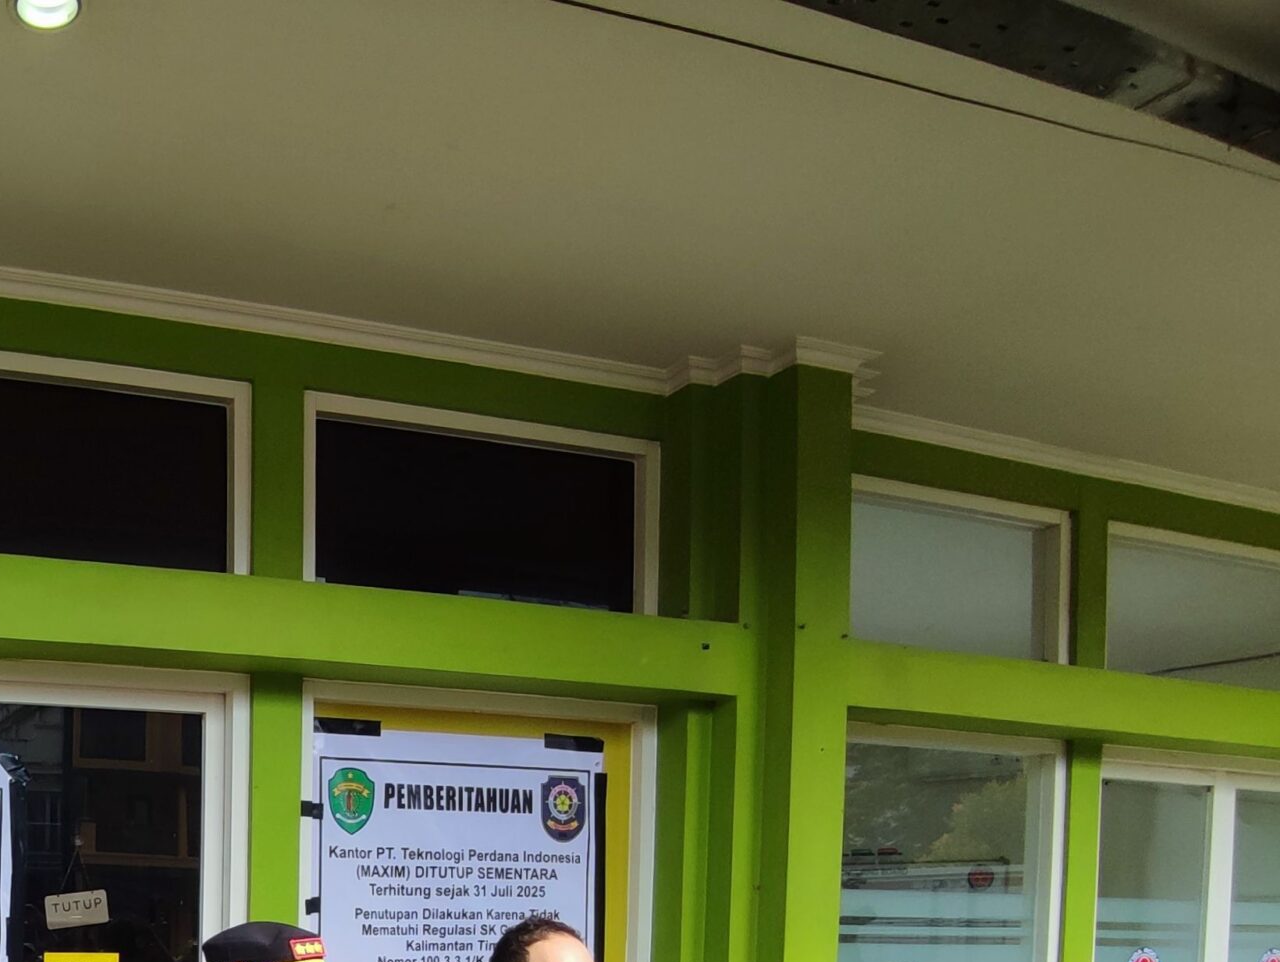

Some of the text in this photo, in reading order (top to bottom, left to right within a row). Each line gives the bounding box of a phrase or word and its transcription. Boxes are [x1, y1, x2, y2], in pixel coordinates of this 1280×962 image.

[383, 782, 533, 815] PEMBERITAHUAN
[328, 845, 581, 865] Kantor PT. Teknologi Perdana Indonesia
[356, 864, 558, 881] (MAXIM) DITUTUP SEMENTARA
[368, 883, 546, 901] Terhitung sejak 31 Juli 2025
[52, 897, 102, 913] TUTUP
[354, 907, 560, 923] Penutupan Dilakukan Karena Tidak
[361, 923, 419, 936] Mematuhi
[422, 923, 476, 939] Regulasi
[479, 923, 497, 936] SK
[406, 939, 474, 952] Kalimantan
